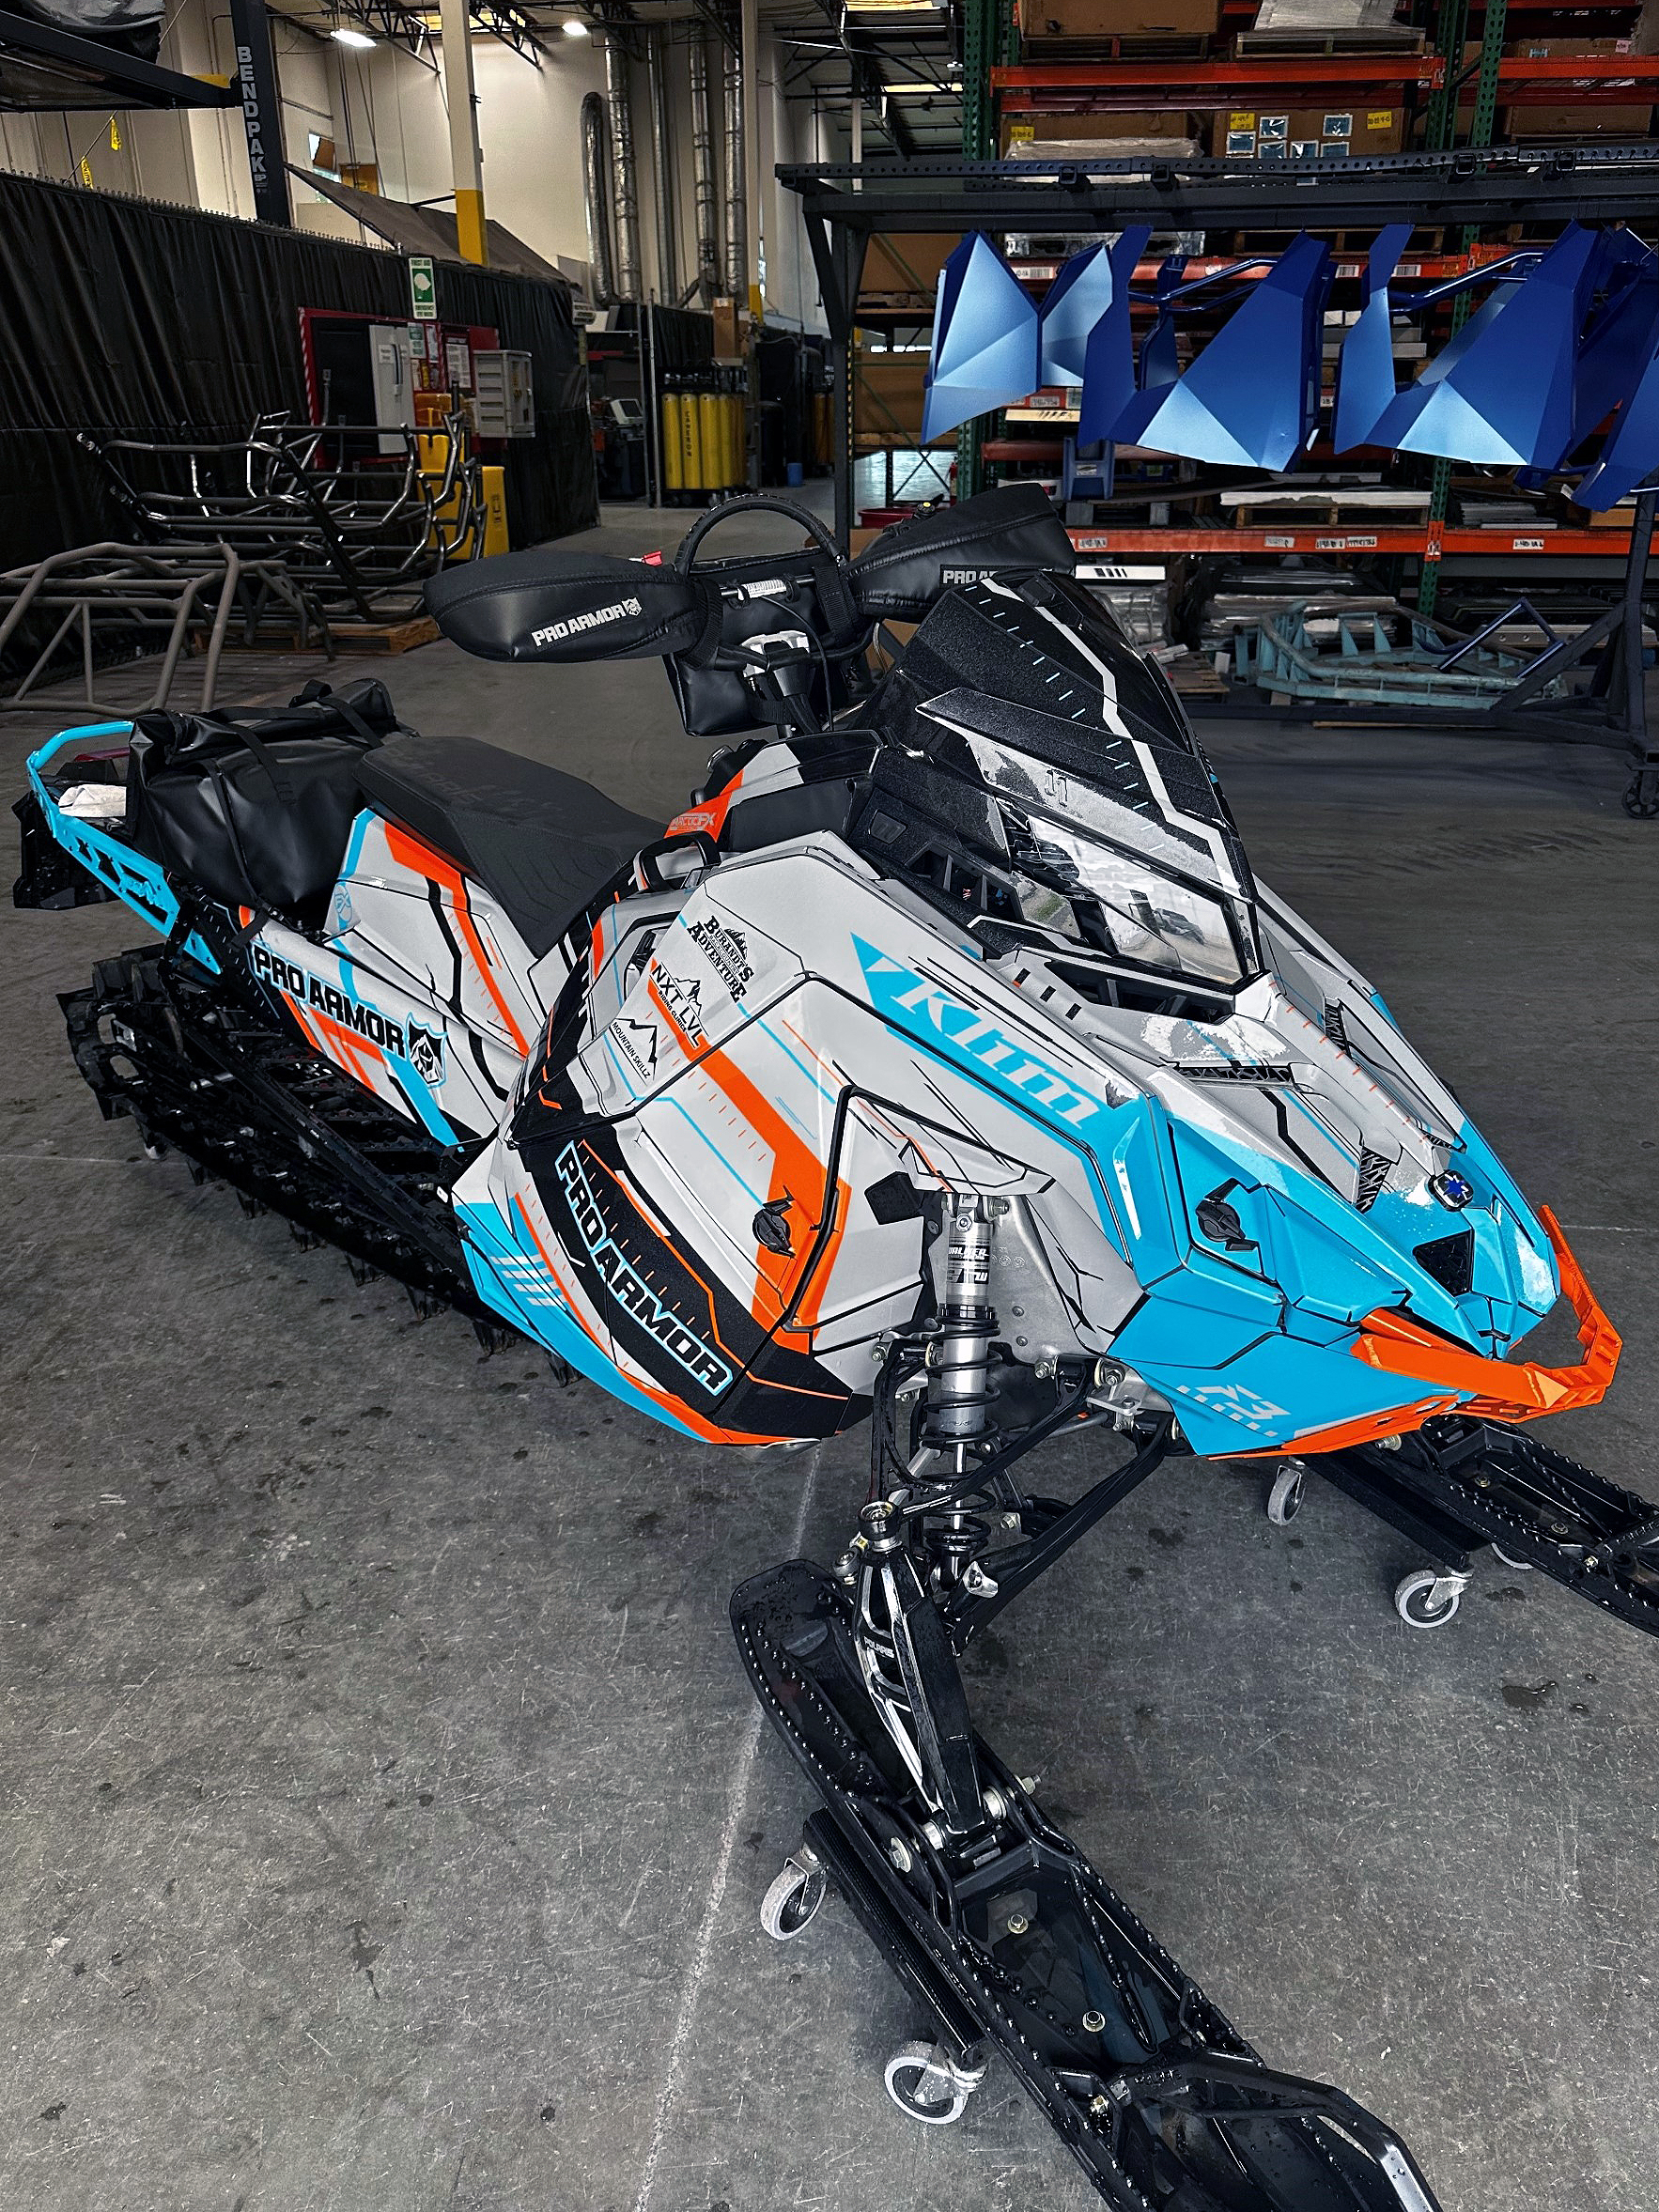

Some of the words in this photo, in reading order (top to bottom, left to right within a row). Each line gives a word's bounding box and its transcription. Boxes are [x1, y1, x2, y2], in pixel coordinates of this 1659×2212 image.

[237, 46, 267, 173] BENDPAK
[942, 569, 977, 584] PRO
[531, 622, 569, 647] PRO
[566, 604, 627, 634] ARMOR
[686, 920, 748, 1004] ADVENTURE
[703, 915, 755, 982] BURANDT'S
[253, 944, 306, 1000] PRO
[308, 973, 406, 1059] ARMOR
[651, 964, 684, 1004] NXT
[678, 1005, 704, 1046] LVL
[658, 989, 674, 1013] RIDING
[671, 1009, 688, 1033] CLINICS
[612, 1021, 637, 1059] MOUNTAIN
[632, 1054, 651, 1079] SKILLZ
[555, 1140, 607, 1252] PRO
[590, 1238, 733, 1396] ARMOR
